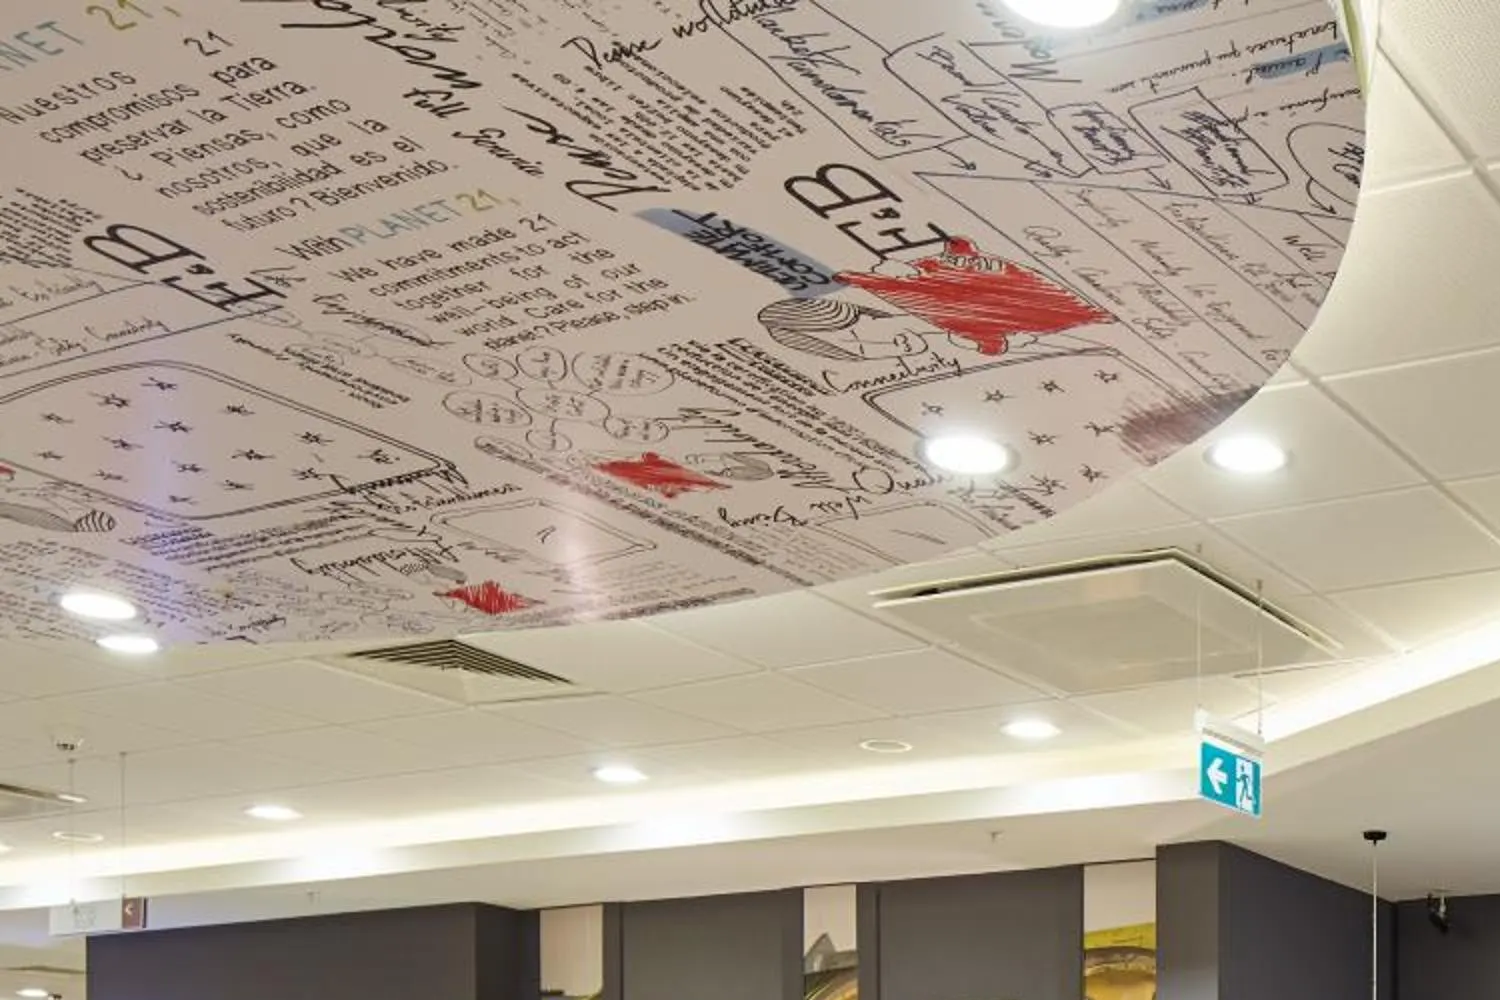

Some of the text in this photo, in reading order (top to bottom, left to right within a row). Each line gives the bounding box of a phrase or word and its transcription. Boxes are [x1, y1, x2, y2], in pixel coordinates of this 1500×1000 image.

[183, 30, 234, 56] 21
[39, 57, 278, 143] compromisos para
[276, 99, 351, 129] como
[80, 119, 193, 166] preservar
[187, 108, 228, 124] la
[290, 133, 342, 158] que
[348, 119, 390, 135] la
[349, 151, 387, 167] es
[274, 236, 353, 261] With
[338, 199, 462, 243] PLANET
[327, 213, 557, 283] We have made 21
[369, 231, 590, 297] commitments to act
[394, 248, 616, 310] together for the
[563, 274, 590, 289] of
[600, 263, 641, 280] our
[452, 314, 518, 336] world
[584, 289, 623, 302] for
[623, 278, 669, 294] the
